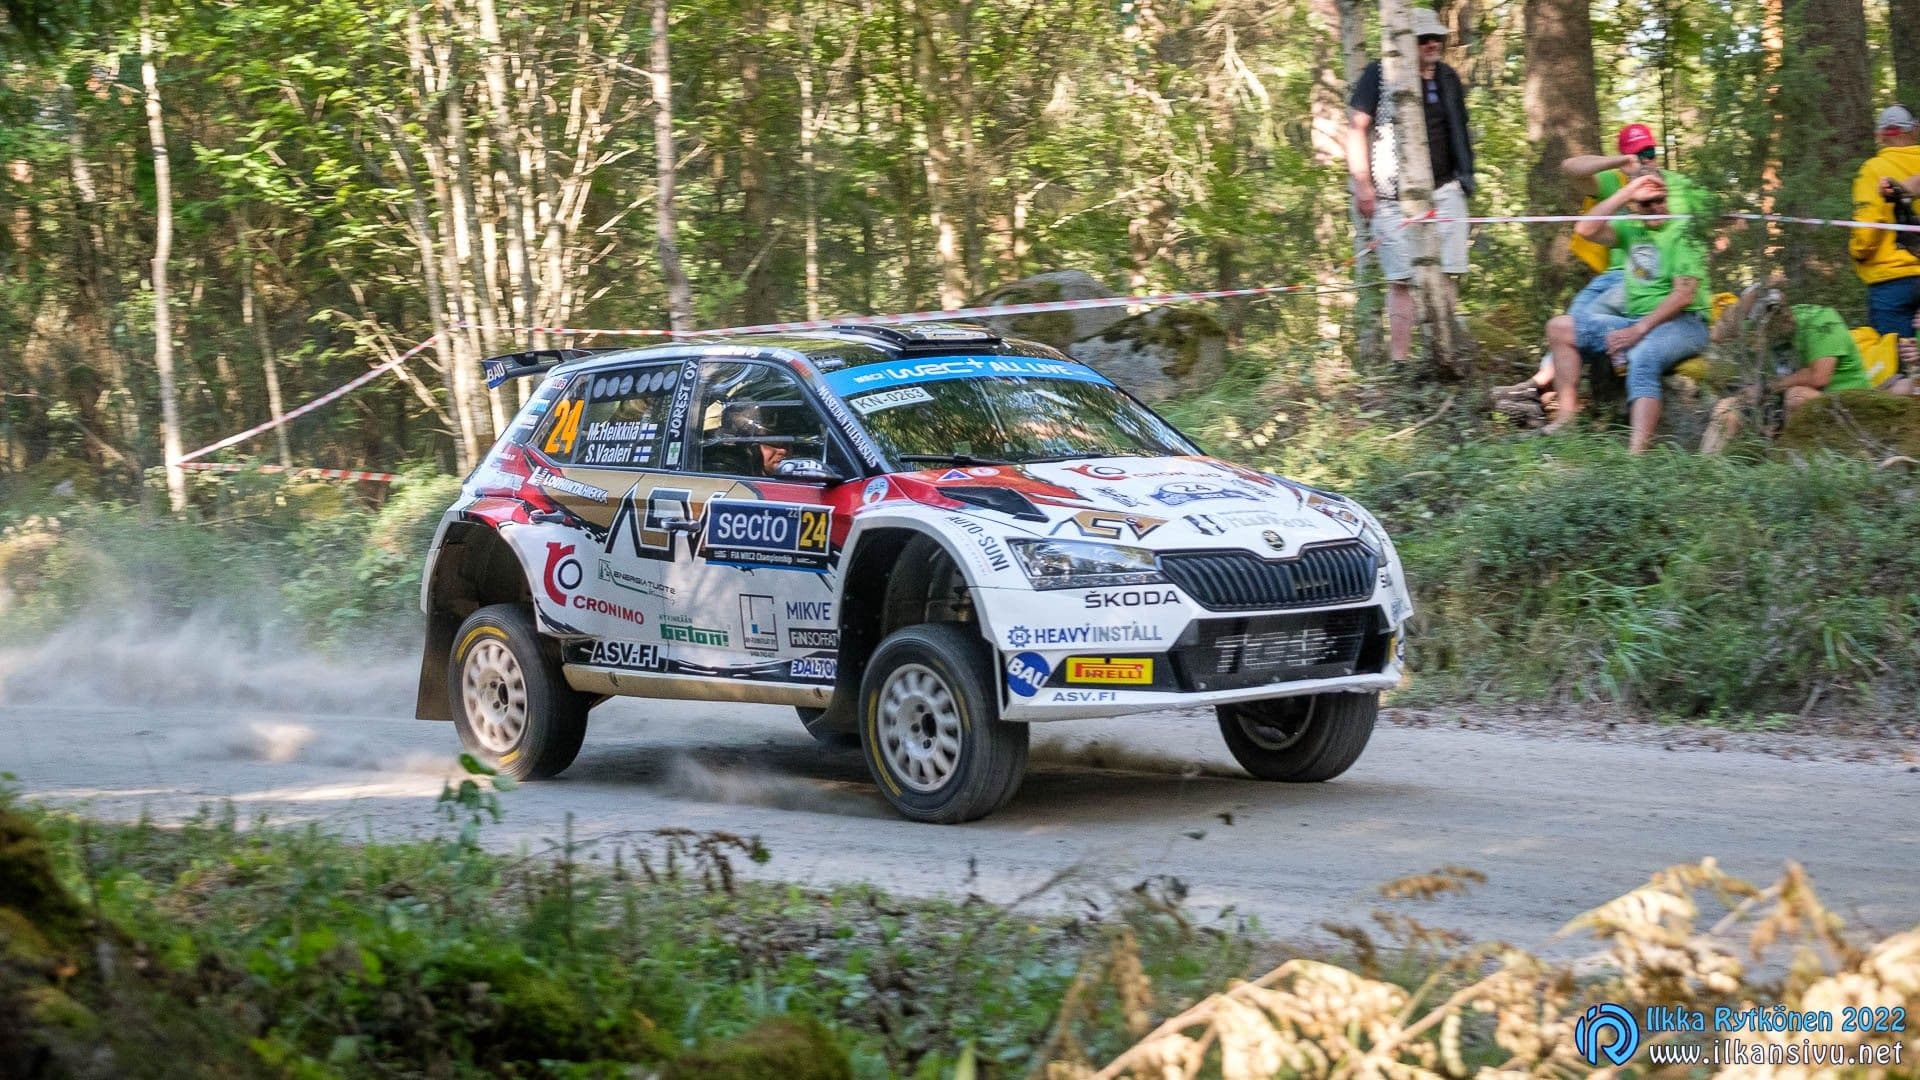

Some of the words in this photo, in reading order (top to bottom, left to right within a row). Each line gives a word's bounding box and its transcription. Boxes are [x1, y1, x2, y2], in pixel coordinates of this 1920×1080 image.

[486, 363, 505, 381] BAU
[987, 360, 1026, 373] ALL
[1027, 363, 1073, 376] LIVE
[670, 385, 691, 438] JOREST
[684, 360, 697, 380] OY
[859, 387, 924, 409] KN-0263
[543, 399, 585, 455] 24
[587, 421, 641, 441] M.Heikkilä
[585, 444, 633, 463] S.Vaaleri
[717, 509, 789, 543] secto
[799, 511, 828, 548] 24
[946, 516, 1011, 572] AUTO-SUNI
[1085, 591, 1181, 609] ŠKODA
[573, 595, 645, 626] CRONIMO
[786, 601, 832, 621] MIKVE
[1009, 657, 1049, 689] BAU
[1074, 662, 1144, 679] PIRELLI
[1052, 691, 1116, 702] ASV.FI
